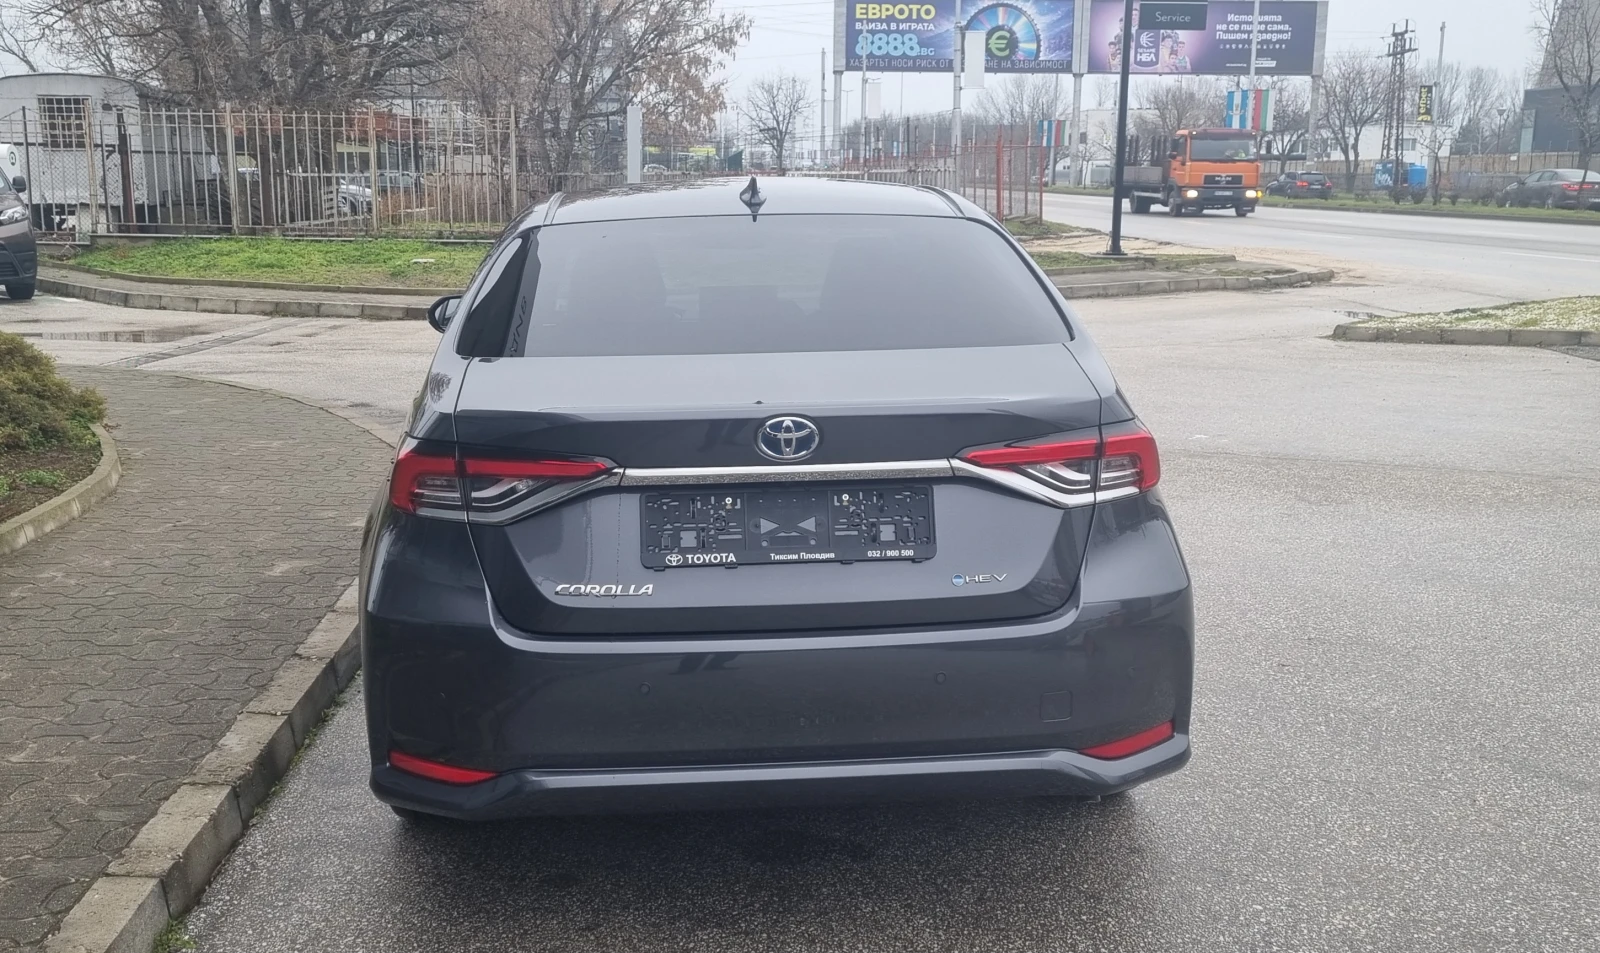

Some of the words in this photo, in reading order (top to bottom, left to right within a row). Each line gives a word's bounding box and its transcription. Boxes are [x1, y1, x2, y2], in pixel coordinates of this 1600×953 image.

[855, 3, 936, 20] ЕВРОТО
[1155, 11, 1192, 23] Service
[1227, 13, 1283, 22] Истоията
[890, 22, 898, 31] В
[899, 22, 935, 31] ИГРАТА
[1216, 31, 1248, 40] Пишем
[891, 59, 914, 68] НОСИ
[916, 59, 937, 68] РИСК
[939, 59, 950, 68] ОТ
[1001, 60, 1012, 69] НА
[1014, 60, 1068, 70] ЗАВИСИМОСТ
[800, 552, 835, 560] Пловдив
[901, 549, 914, 557] 500
[686, 553, 737, 564] TOYOTA
[555, 583, 654, 598] COROLLA
